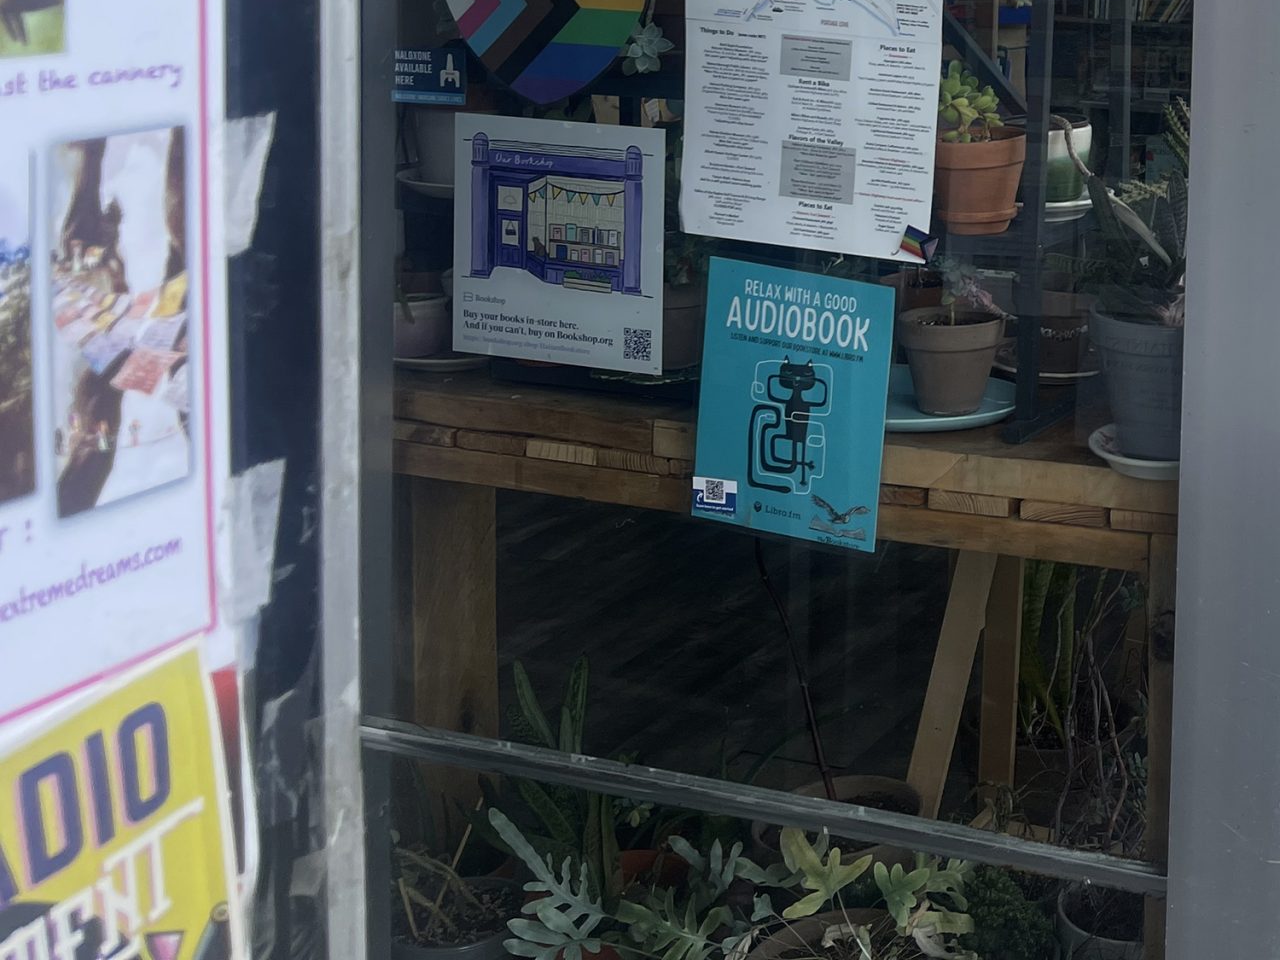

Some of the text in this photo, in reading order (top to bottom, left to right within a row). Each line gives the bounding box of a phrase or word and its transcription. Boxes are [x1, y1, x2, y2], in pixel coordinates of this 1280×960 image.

[700, 26, 718, 35] Things
[394, 50, 432, 62] NALOXONE
[394, 62, 433, 74] AVAILABLE
[38, 68, 79, 92] the
[395, 75, 415, 86] HERE
[788, 134, 808, 142] Flavors
[827, 138, 844, 147] Valley
[798, 201, 815, 209] Places
[475, 294, 506, 305] Bookshop
[744, 279, 857, 313] RELAX WITH A GOOD
[463, 309, 479, 320] Buy
[480, 313, 499, 321] your
[500, 313, 525, 323] books
[559, 320, 579, 330] here.
[726, 295, 870, 352] AUDIOBOOK
[463, 320, 480, 330] And
[481, 322, 488, 331] if
[488, 325, 503, 334] you
[528, 328, 543, 339] buy
[544, 331, 555, 339] on
[557, 330, 614, 346] Bookshop.org
[731, 332, 747, 342] LISTEN
[748, 335, 759, 344] AND
[760, 337, 781, 348] SUPPORT
[782, 340, 792, 349] OUR
[793, 342, 820, 356] BOOKSTORE
[765, 504, 802, 520] Libro.fm
